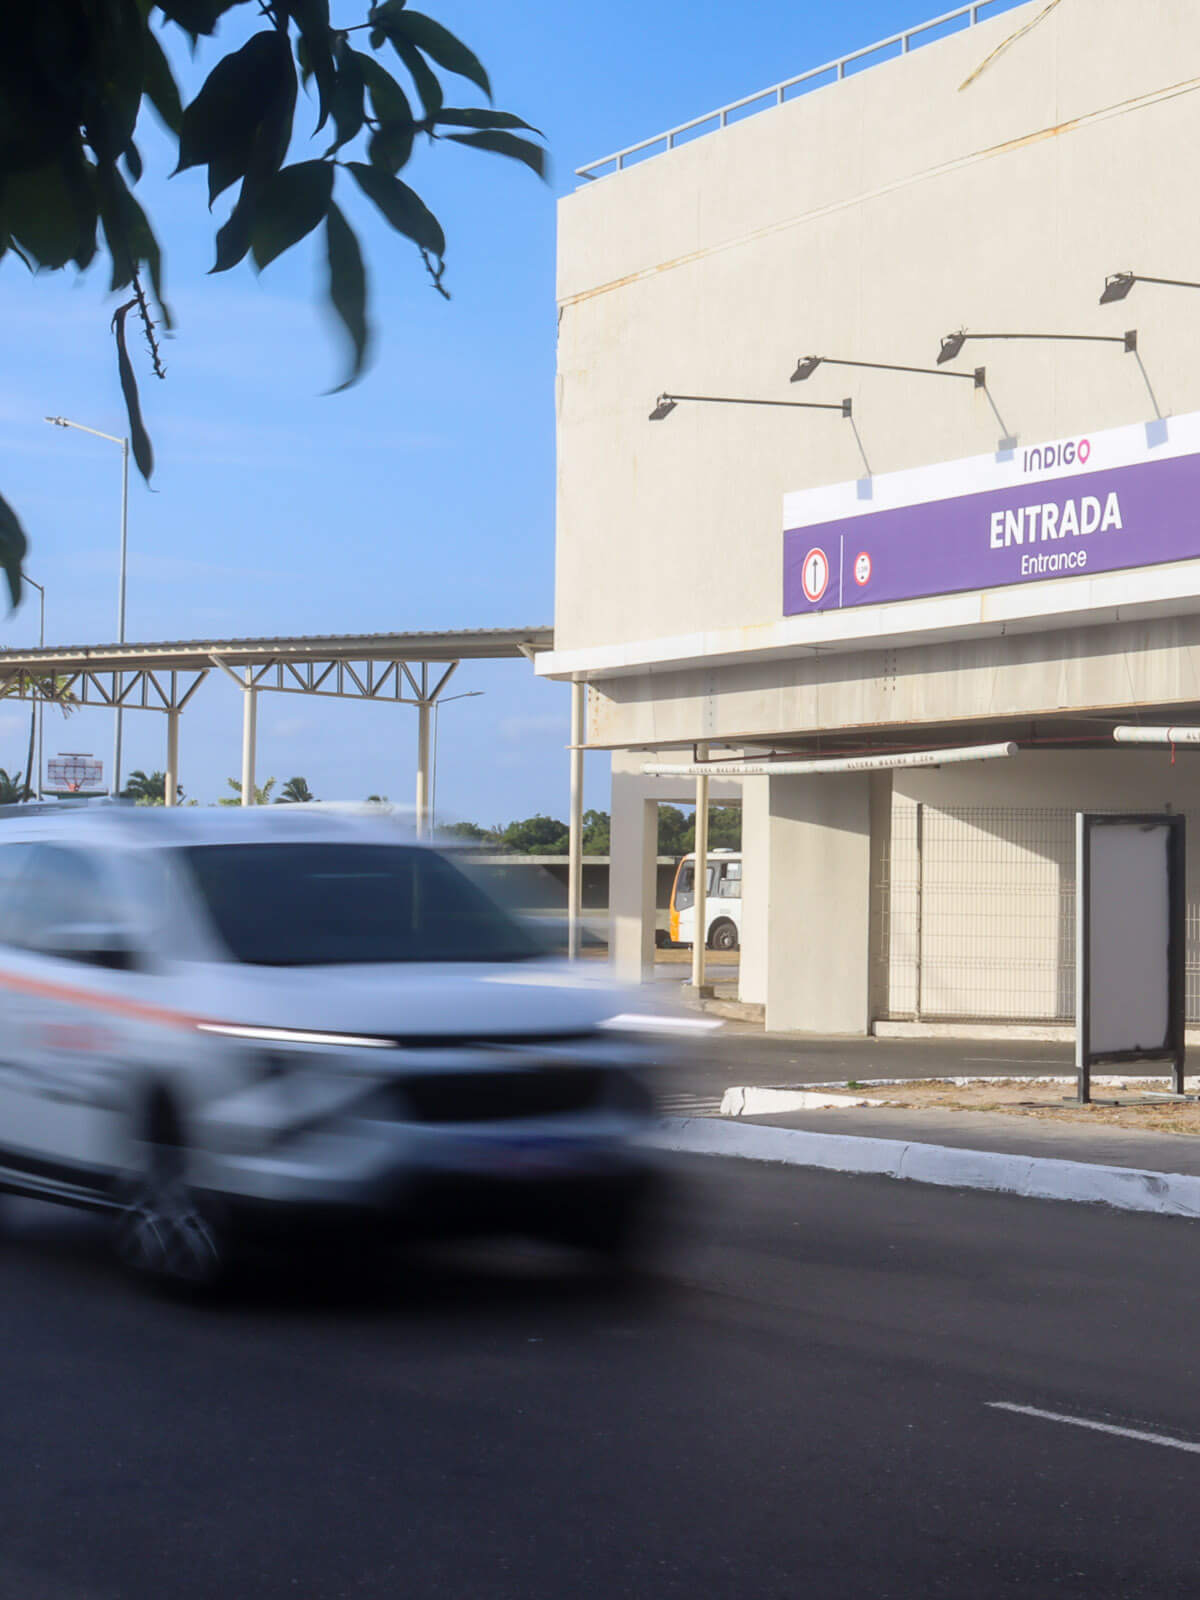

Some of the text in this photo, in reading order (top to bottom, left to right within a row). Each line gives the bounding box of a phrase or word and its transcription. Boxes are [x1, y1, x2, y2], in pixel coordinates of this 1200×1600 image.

[1024, 439, 1091, 473] INDIGO
[990, 492, 1123, 549] ENTRADA
[1021, 550, 1087, 575] Entrance
